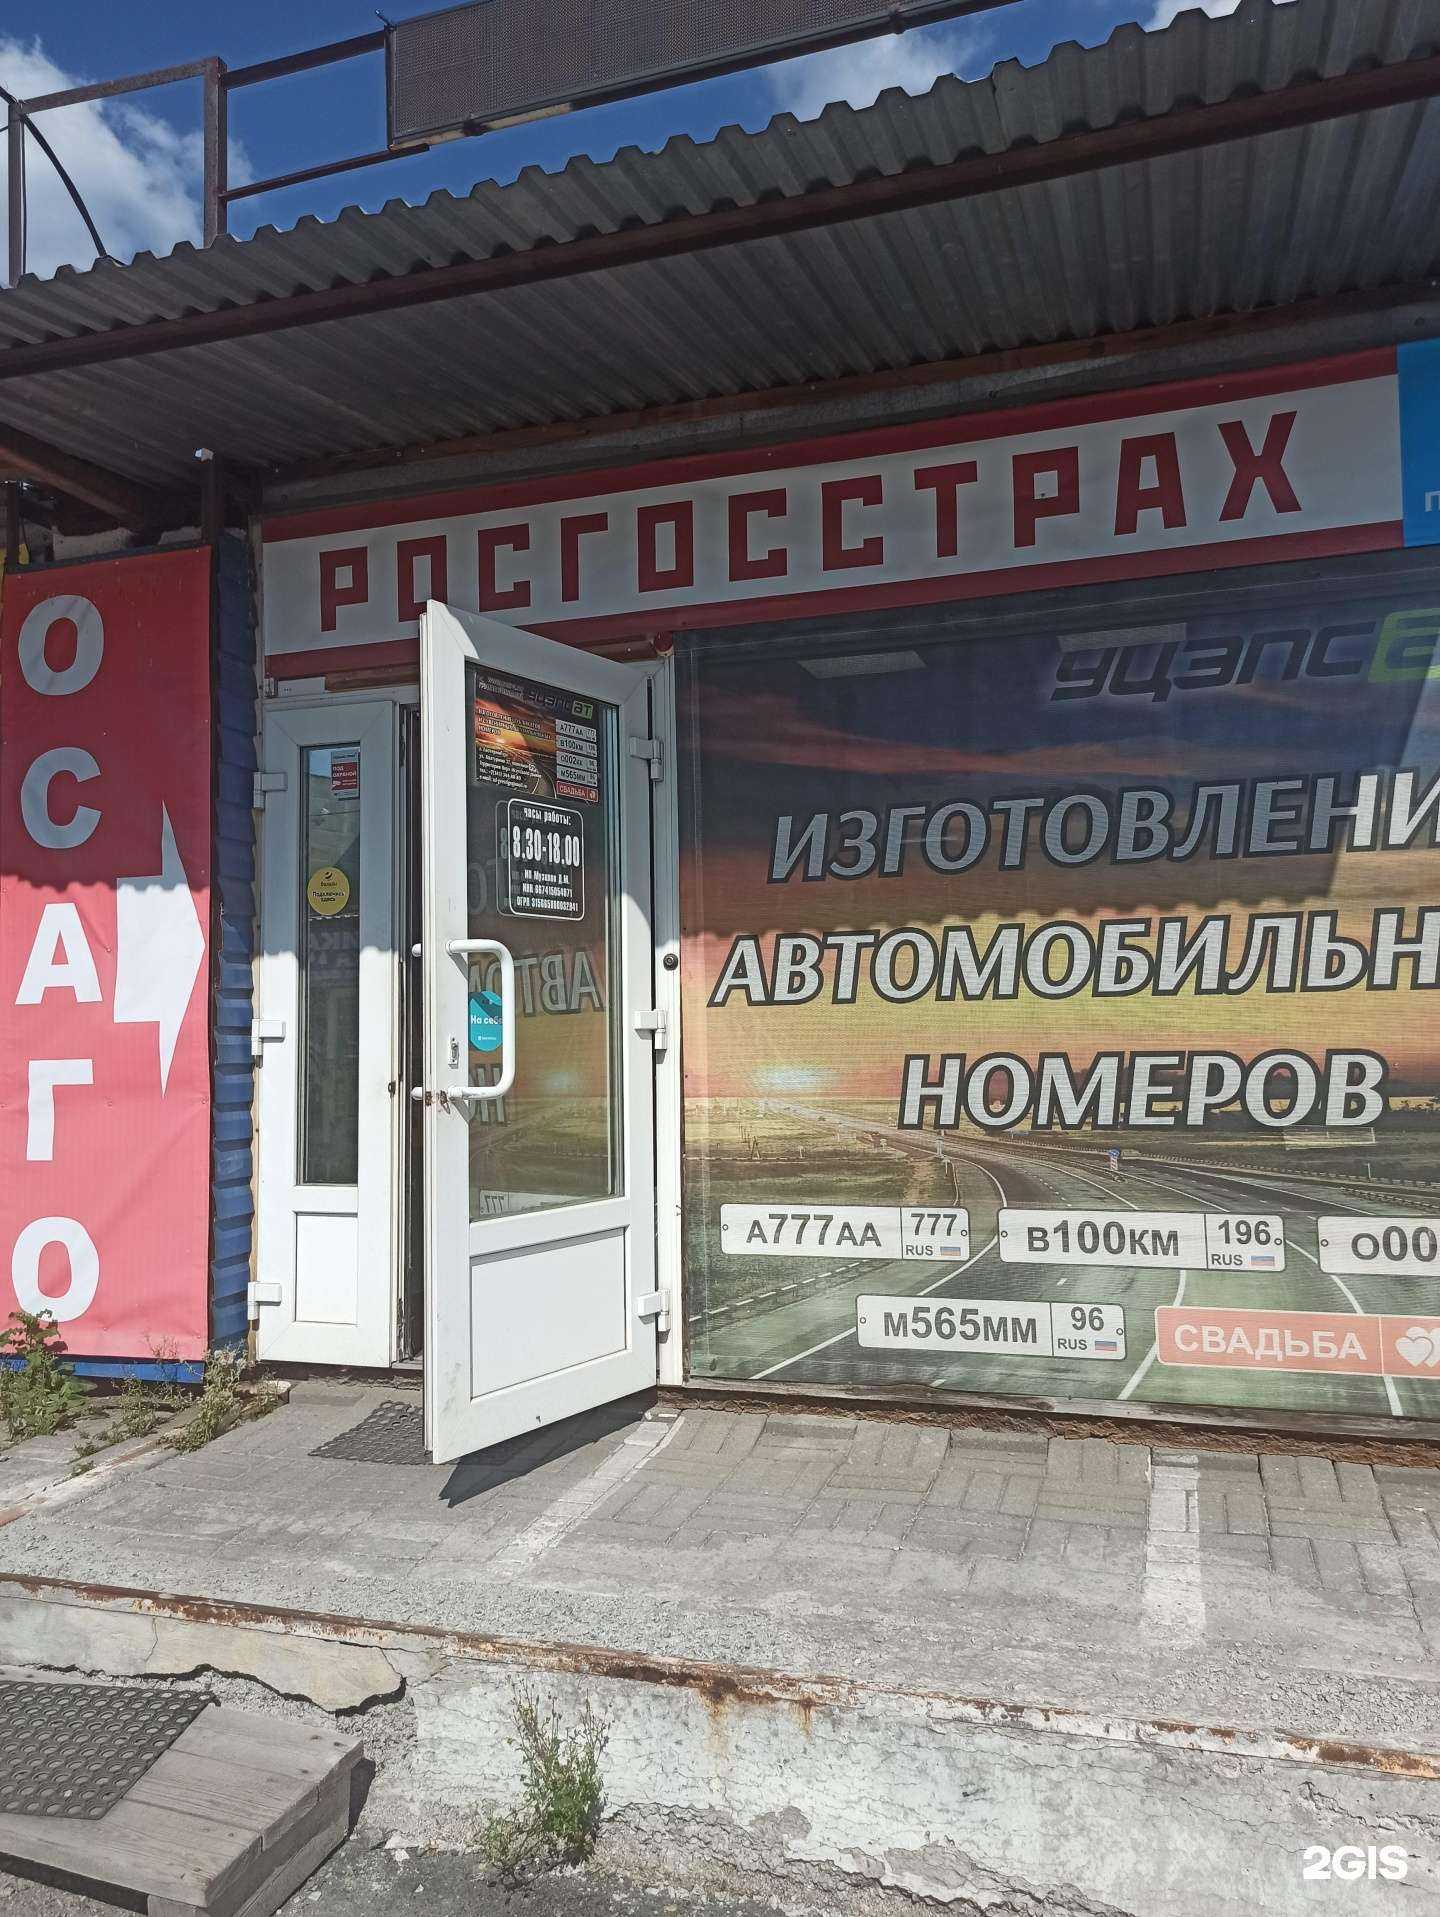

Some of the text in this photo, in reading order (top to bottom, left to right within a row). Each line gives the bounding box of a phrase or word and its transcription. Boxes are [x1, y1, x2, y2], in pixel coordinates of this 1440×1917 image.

[320, 411, 1301, 631] РОСГОССТРАХ
[523, 808, 542, 820] часы
[767, 768, 1440, 883] ИЗГОТОВЛЕНИ
[512, 825, 580, 867] 8.30-18.00
[11, 594, 105, 1321] ОСАГО
[707, 906, 1440, 1007] АВТОМОБИЛЬН
[898, 1048, 1390, 1130] НОМЕРОВ
[745, 1211, 958, 1250] А777АА 777
[1026, 1217, 1272, 1257] В100КМ 196
[905, 1244, 934, 1258] RUS
[1210, 1252, 1244, 1267] RUS
[883, 1305, 1106, 1344] М565ММ 96
[1057, 1337, 1089, 1351] RUS
[1173, 1323, 1368, 1362] СВАДЬБА
